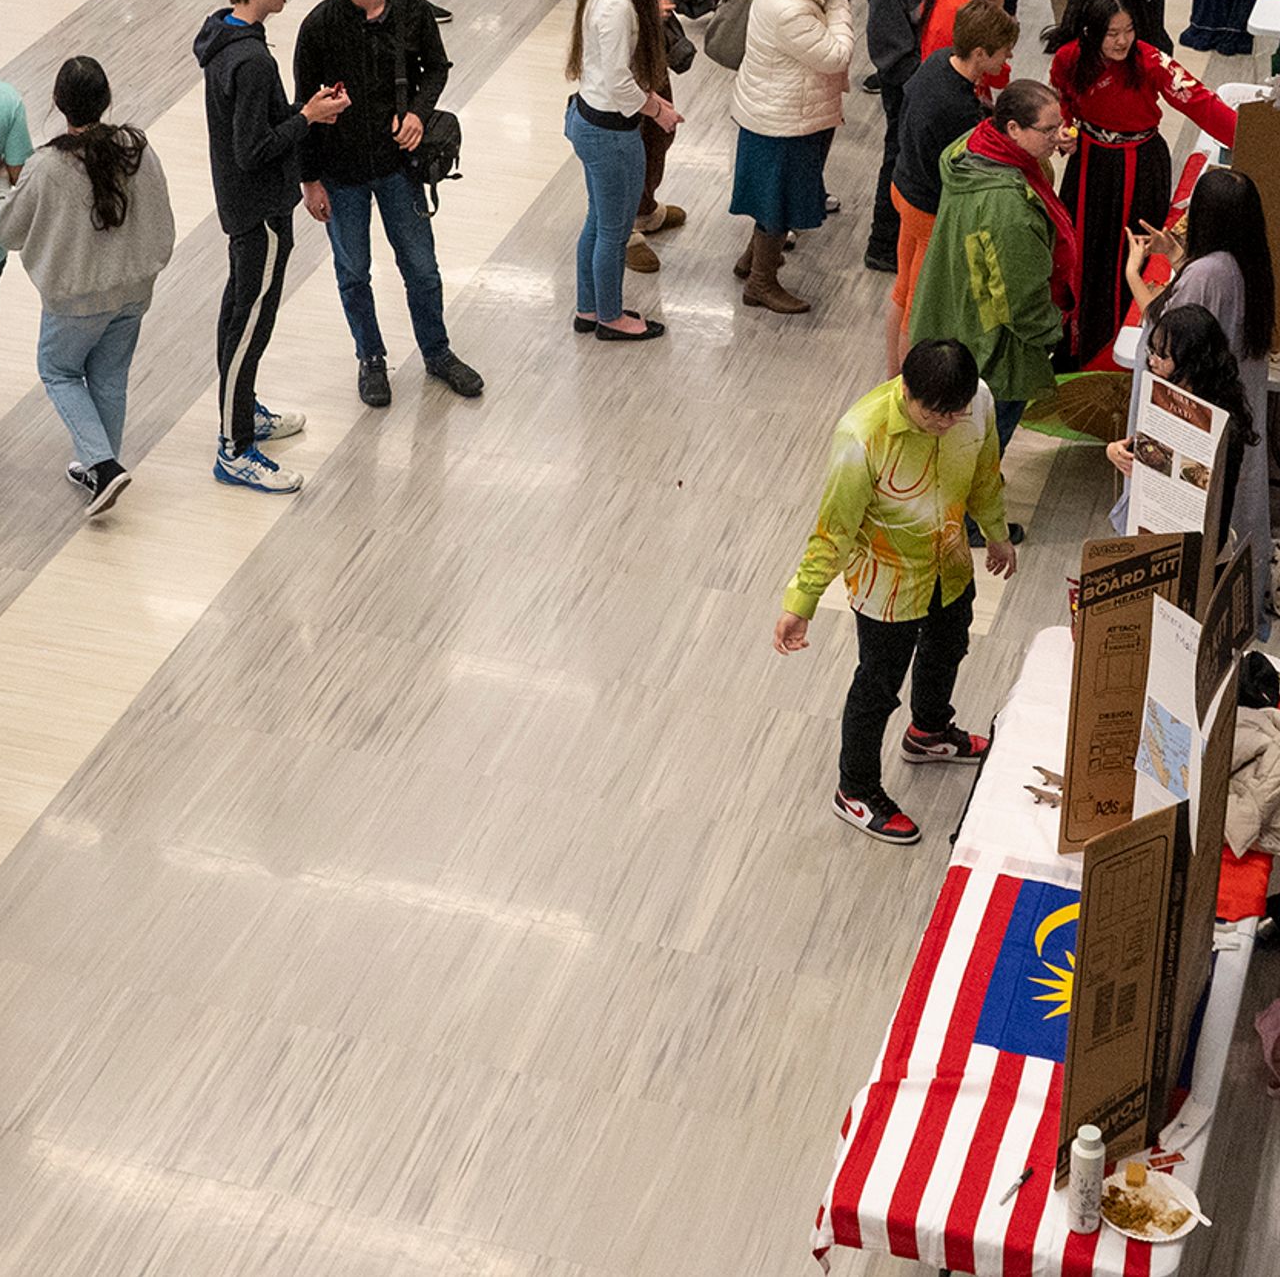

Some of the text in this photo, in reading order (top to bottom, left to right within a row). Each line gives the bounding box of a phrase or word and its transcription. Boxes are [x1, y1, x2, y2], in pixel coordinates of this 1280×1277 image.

[1083, 556, 1180, 601] BOARD KIT
[1114, 586, 1160, 606] HEADER
[1099, 710, 1133, 721] DESIGN
